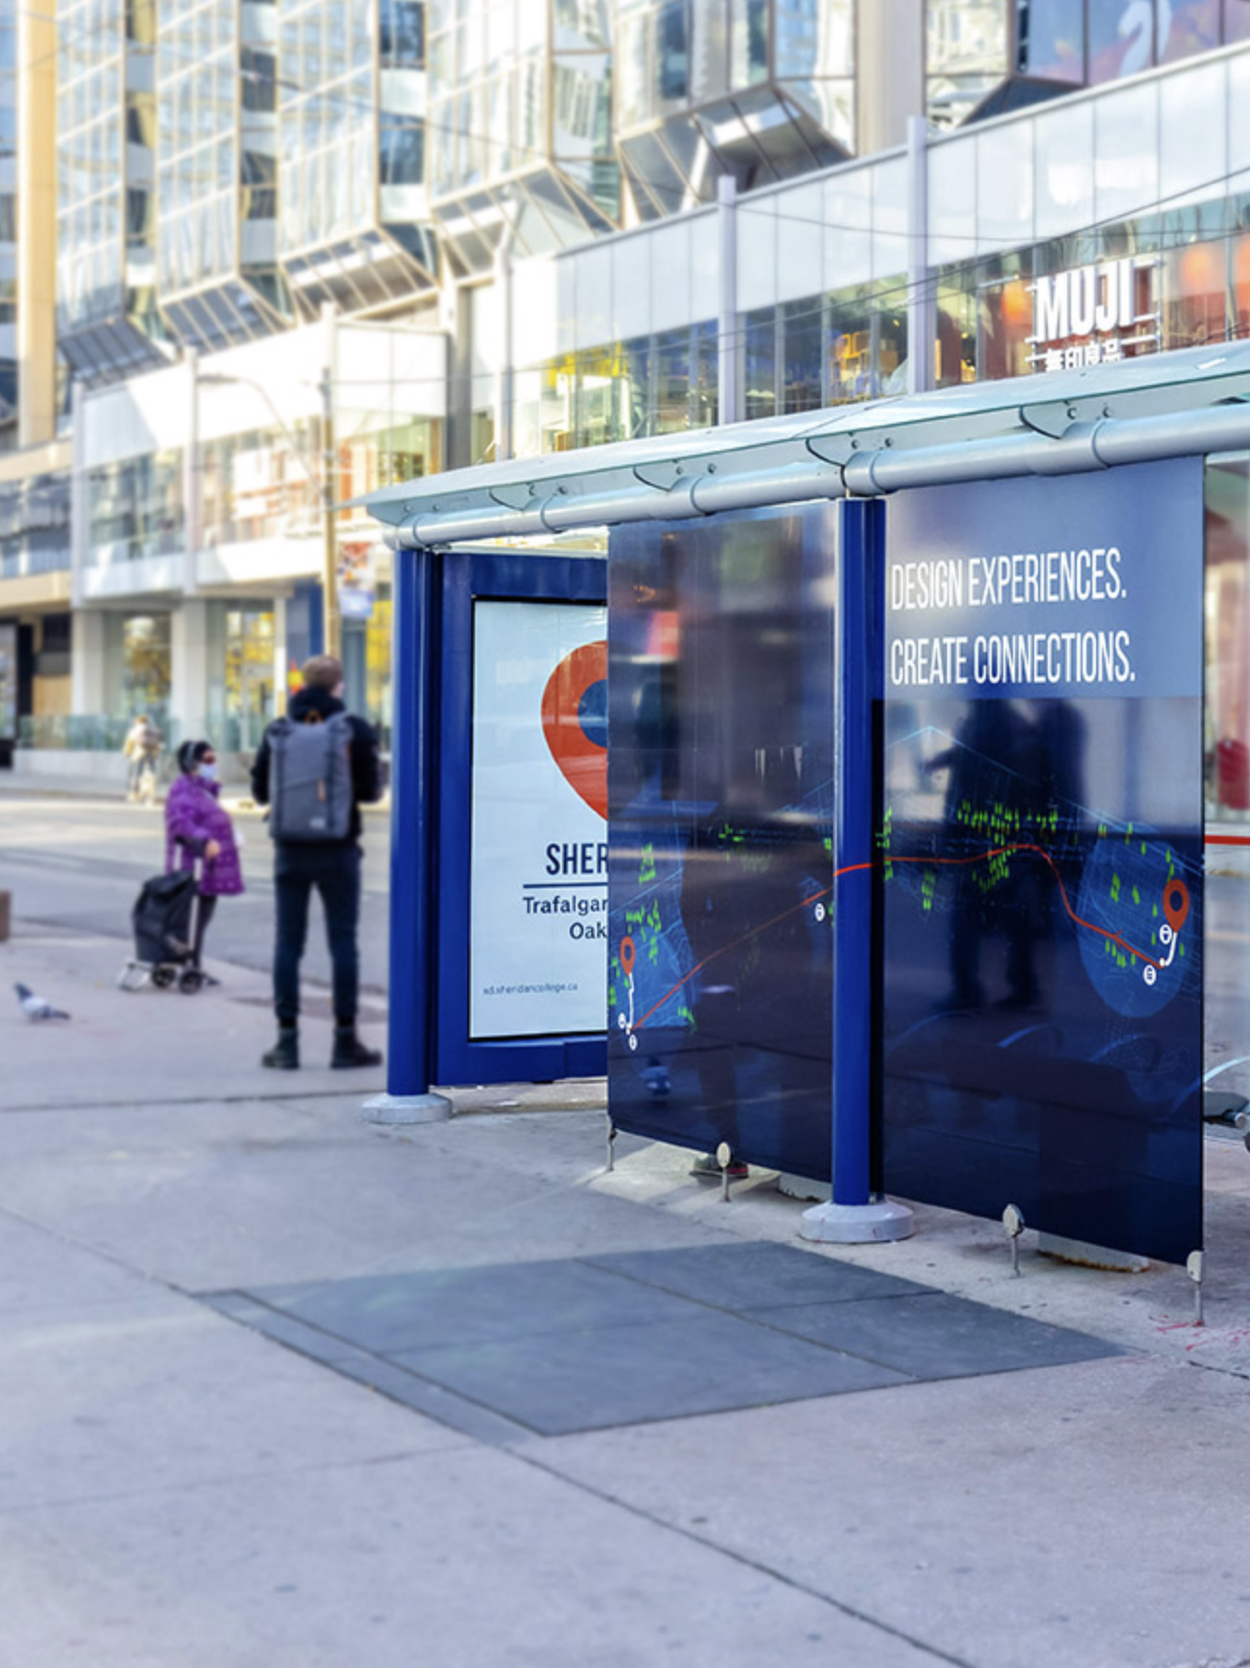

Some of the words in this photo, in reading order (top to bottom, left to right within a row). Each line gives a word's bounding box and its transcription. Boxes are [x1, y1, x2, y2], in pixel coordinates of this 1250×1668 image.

[1036, 258, 1134, 343] MUJI
[891, 559, 963, 610] DESIGN
[968, 547, 1127, 606] EXPERIENCES.
[890, 636, 968, 685] CREATE
[973, 630, 1136, 685] CONNECTIONS.
[522, 895, 609, 916] Trafalgar
[569, 920, 609, 940] Oak
